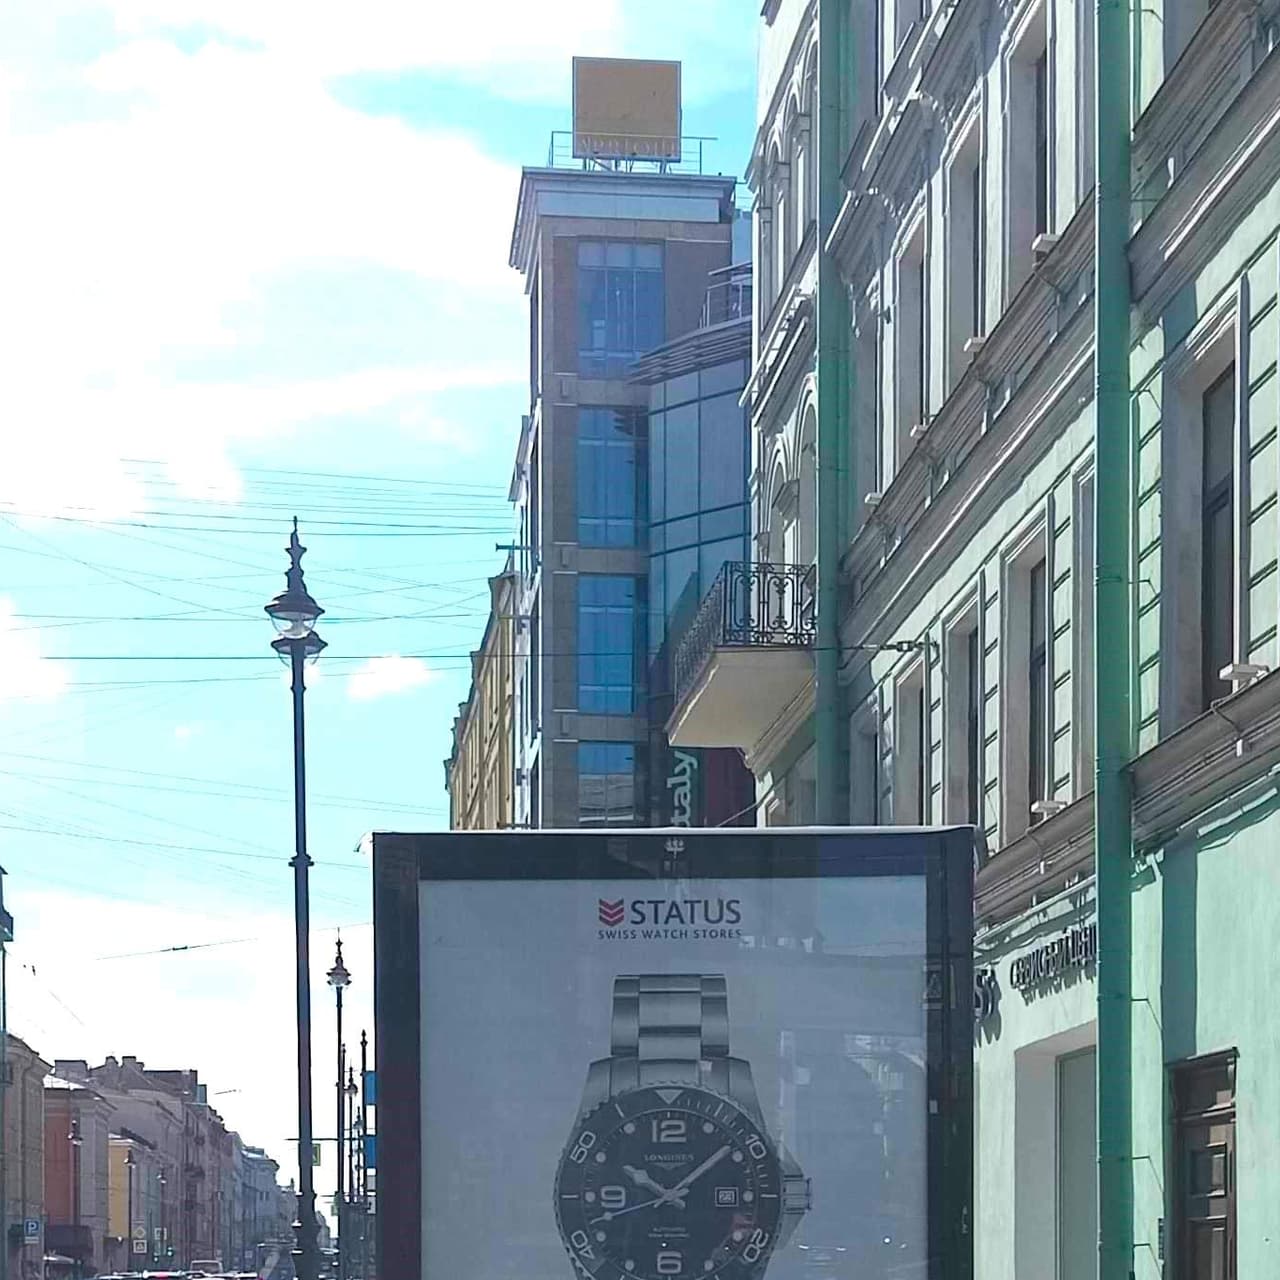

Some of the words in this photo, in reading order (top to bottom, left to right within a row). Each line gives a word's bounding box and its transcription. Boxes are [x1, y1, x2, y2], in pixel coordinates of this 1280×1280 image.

[629, 898, 742, 925] STATUS
[597, 929, 637, 940] SWISS
[641, 929, 688, 940] WATCH
[693, 929, 742, 940] STORES
[651, 1118, 688, 1144] 12
[569, 1130, 597, 1165] 50
[744, 1133, 766, 1160] 10
[599, 1185, 626, 1208] 9
[570, 1229, 596, 1260] 40
[742, 1227, 770, 1263] 20
[656, 1249, 685, 1275] 6
